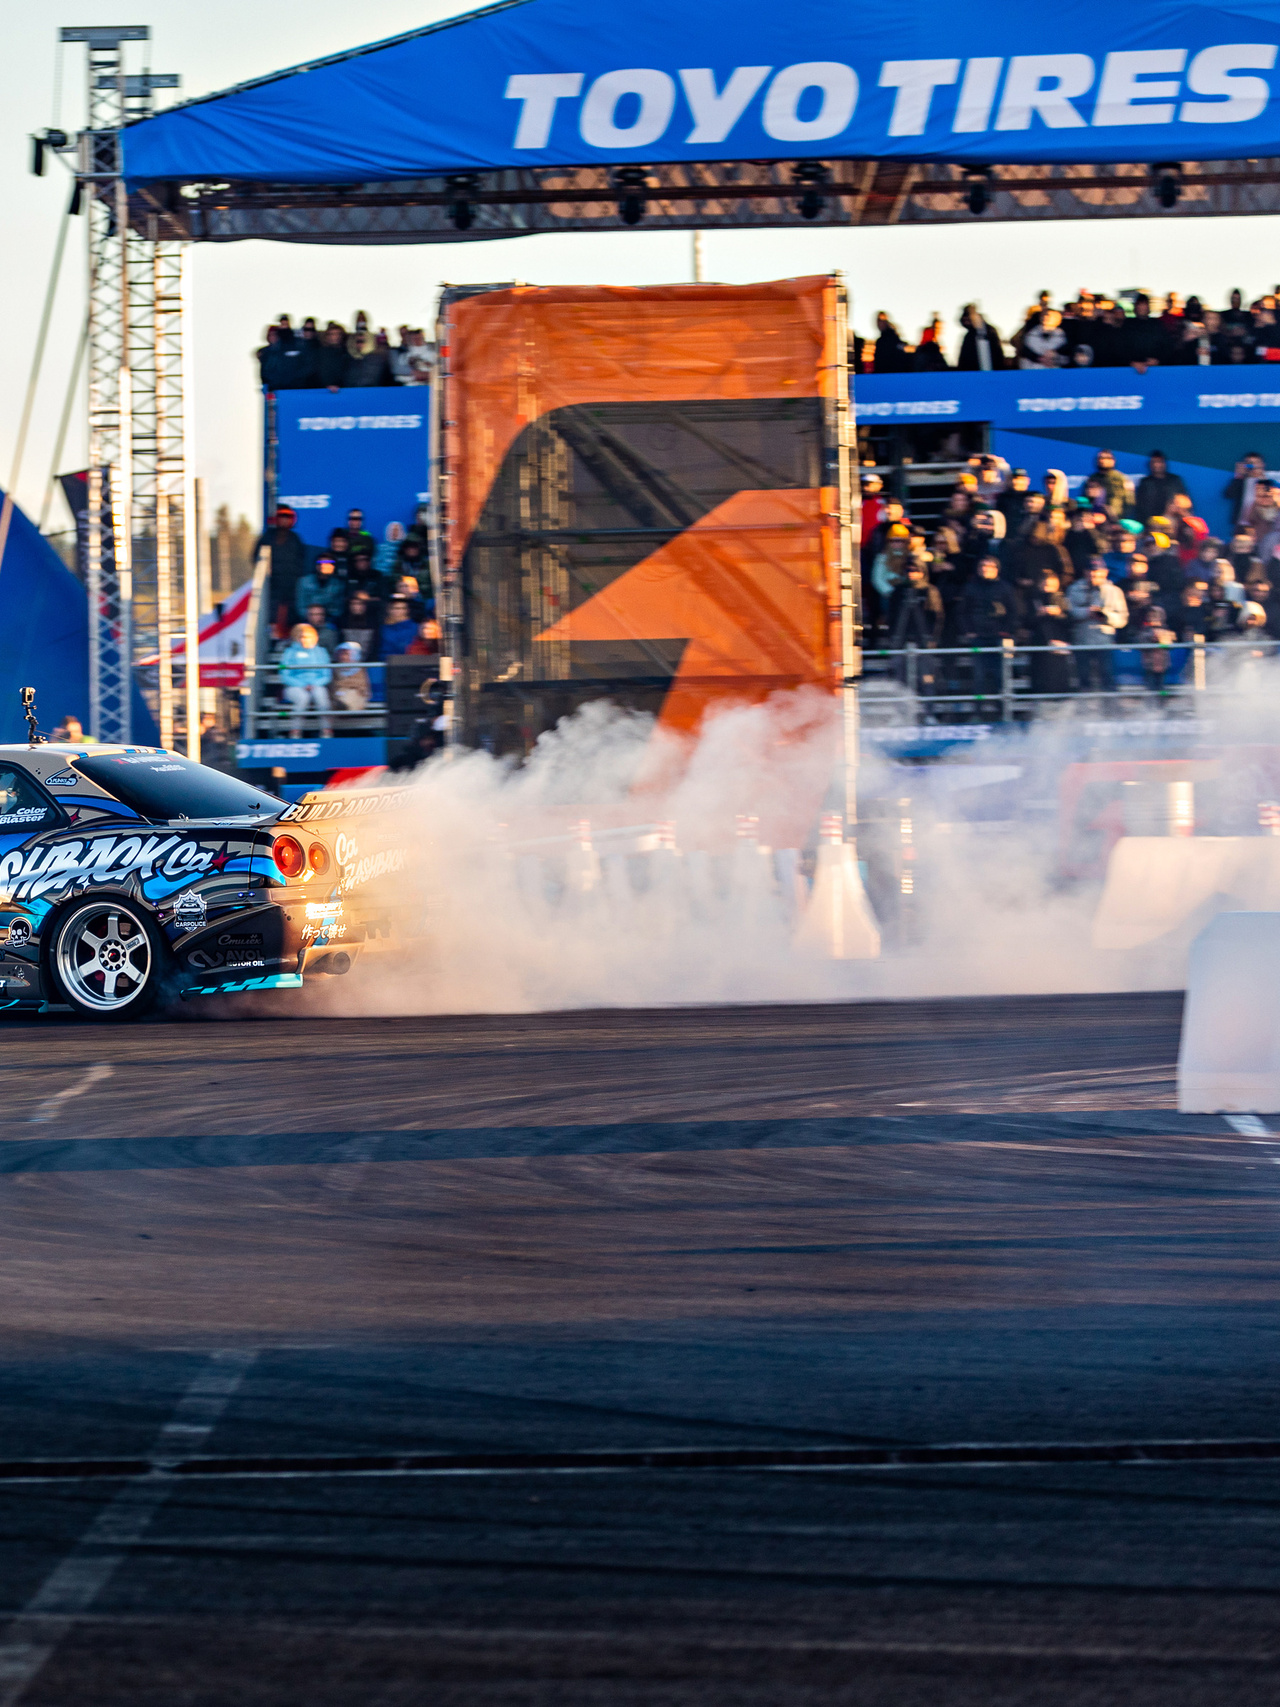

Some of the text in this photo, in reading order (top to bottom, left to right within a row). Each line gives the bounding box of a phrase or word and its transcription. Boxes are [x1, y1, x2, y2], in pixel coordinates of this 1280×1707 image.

[504, 43, 1280, 150] TOYO TIRES
[854, 399, 960, 417] OYO TIRES
[1017, 395, 1144, 412] TOYO TIRES
[1197, 393, 1257, 408] TOYO
[297, 414, 422, 430] TOYO TIRES
[251, 742, 322, 758] TIRES
[16, 807, 48, 815] Color
[278, 789, 418, 822] BUILD AND DEST
